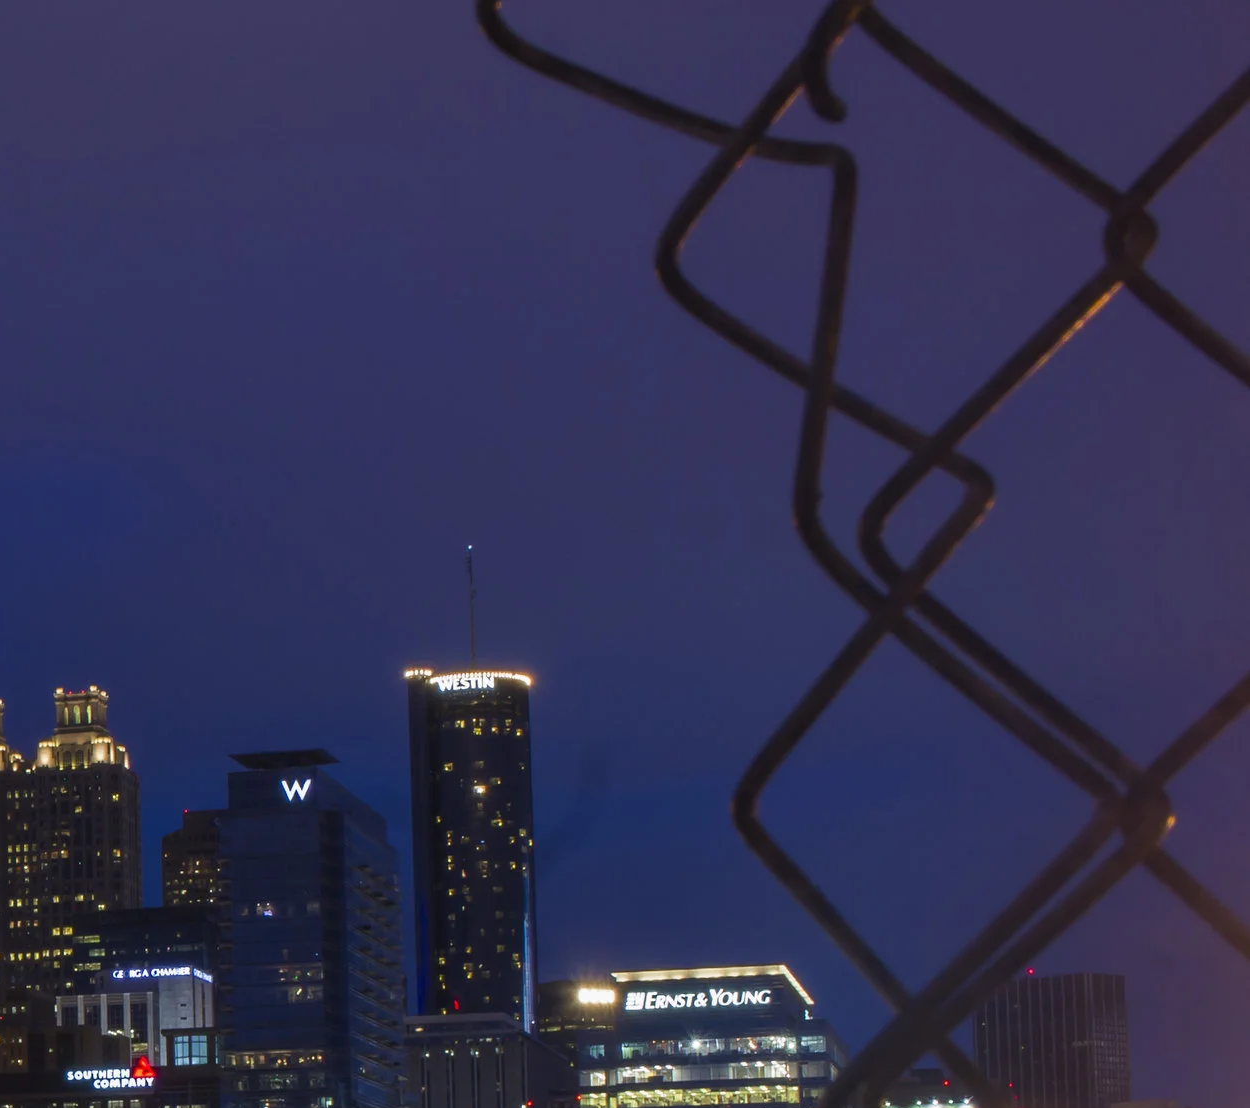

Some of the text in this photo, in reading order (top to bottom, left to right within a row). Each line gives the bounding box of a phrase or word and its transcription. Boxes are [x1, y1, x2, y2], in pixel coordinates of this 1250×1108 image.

[438, 676, 494, 691] WESTIN
[281, 779, 311, 801] W
[67, 1069, 130, 1080] SOUTHERN
[93, 1077, 155, 1089] COMPANY
